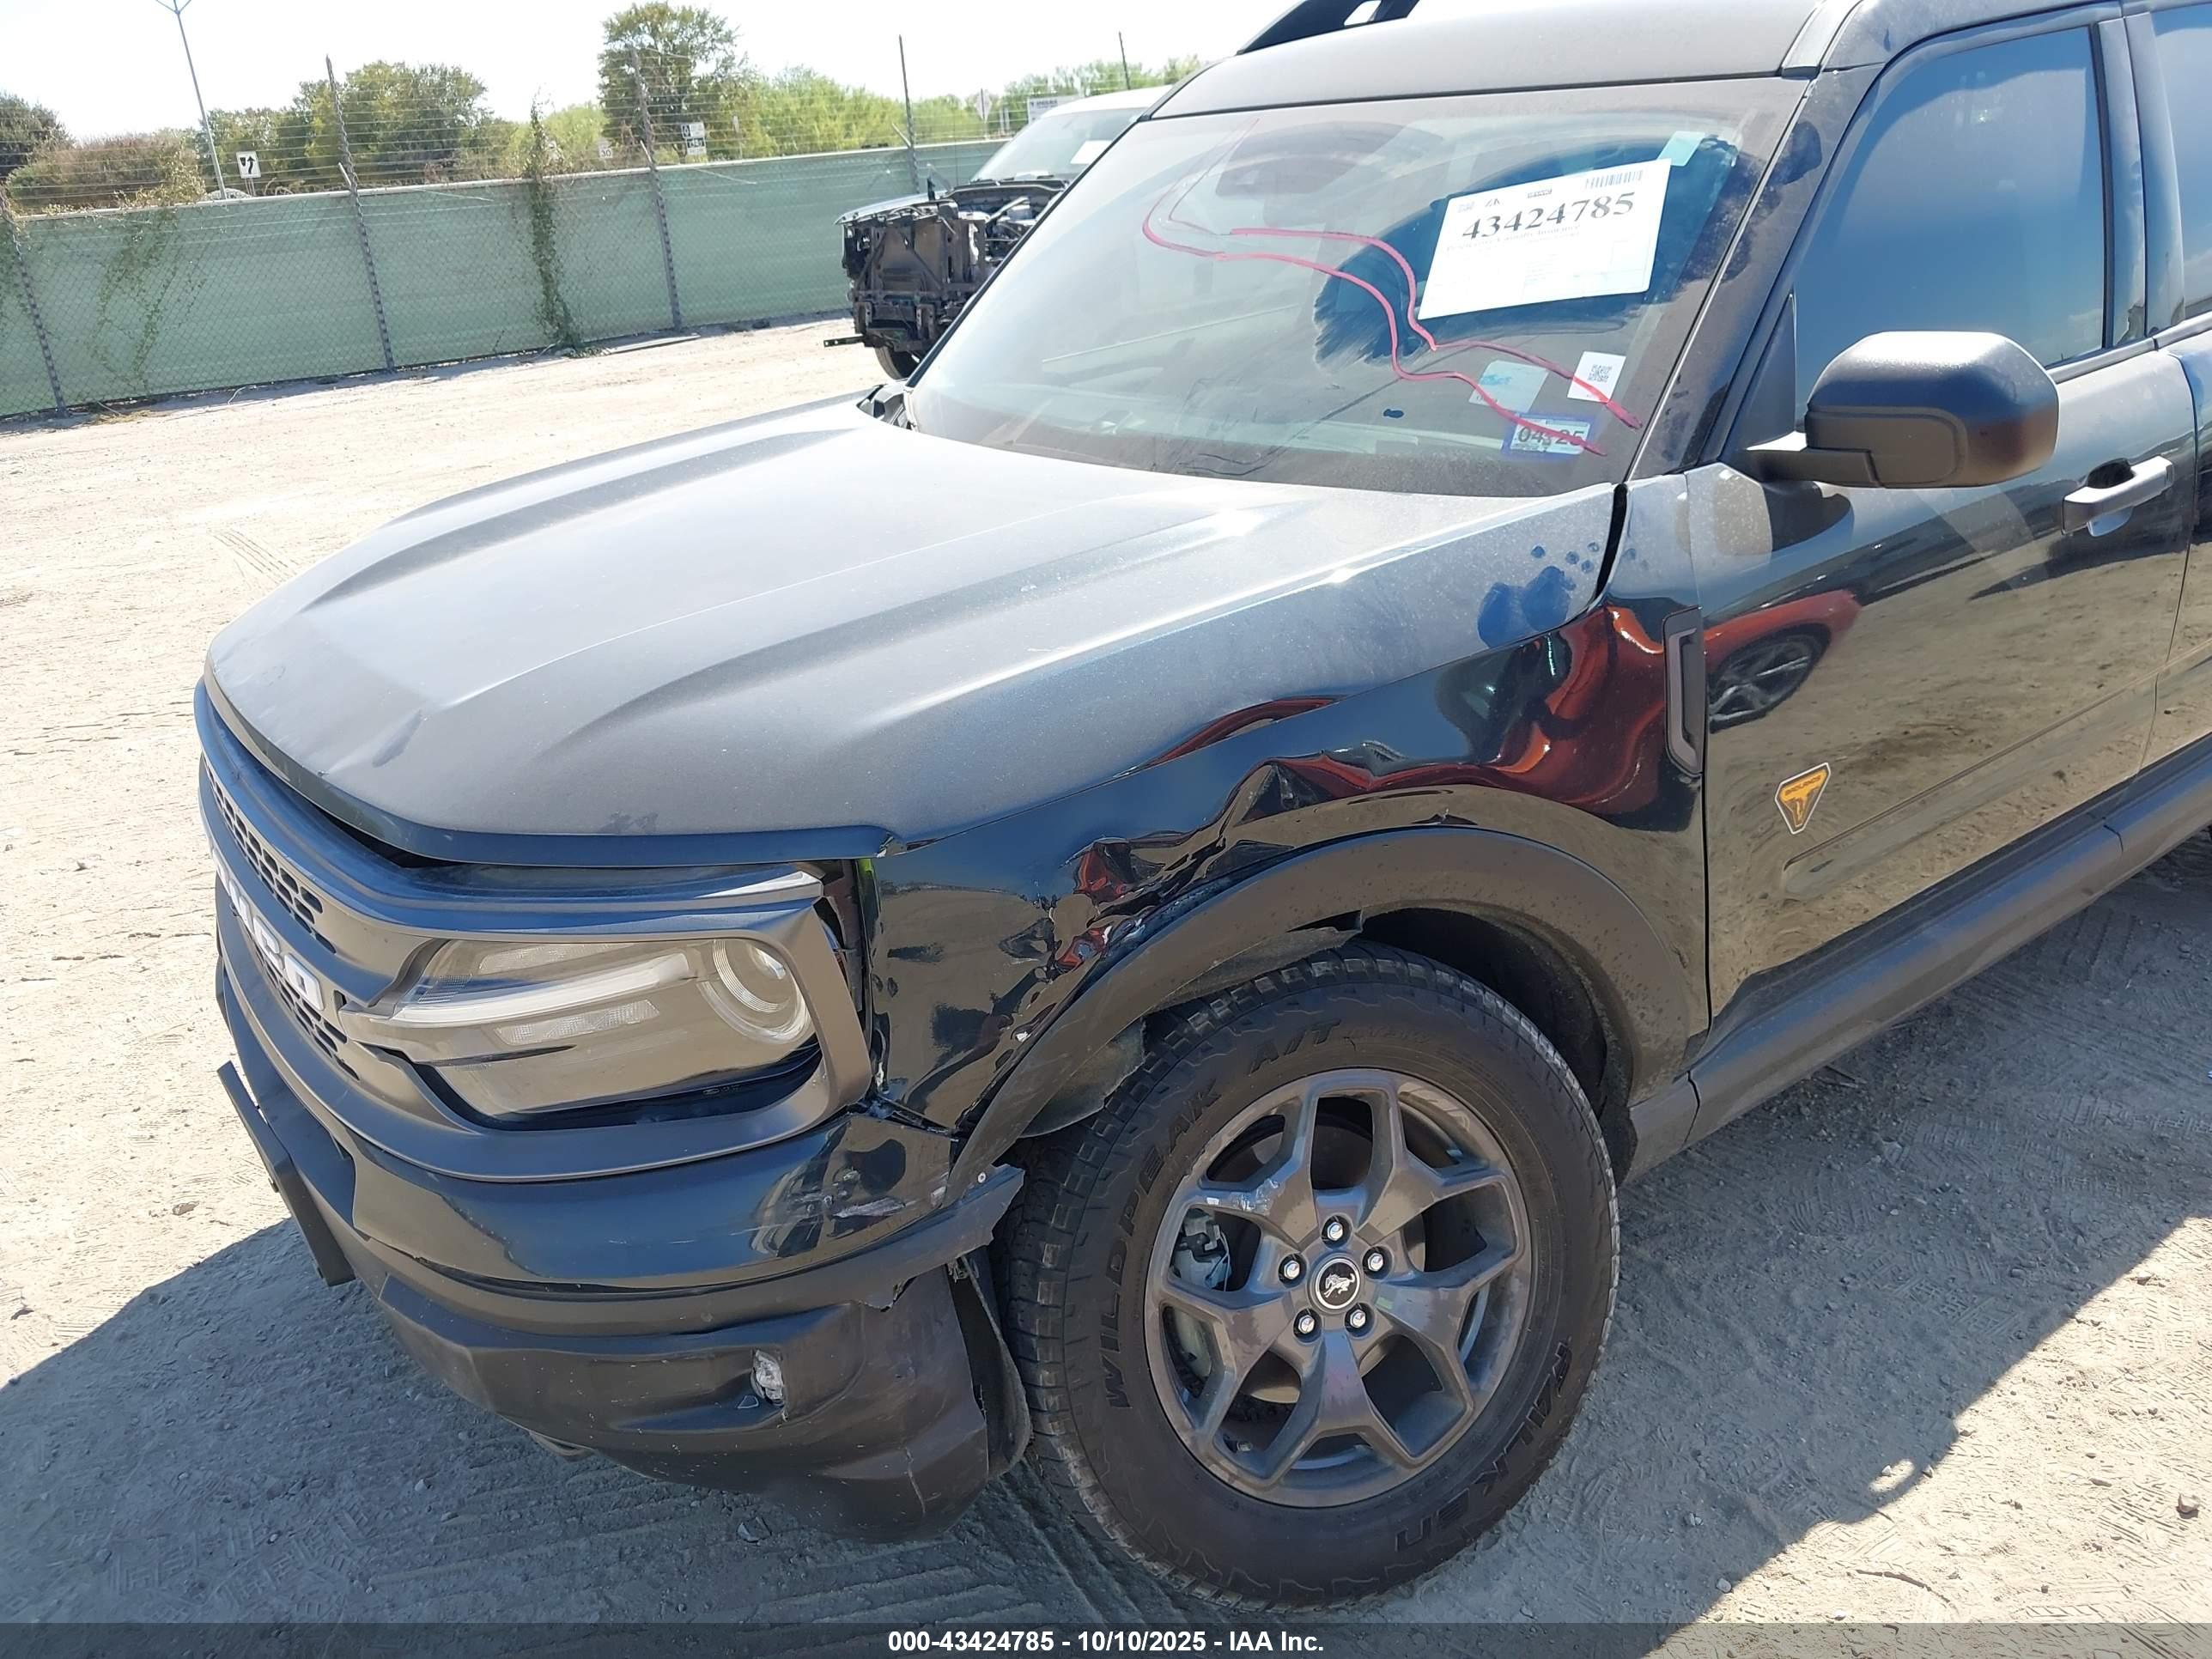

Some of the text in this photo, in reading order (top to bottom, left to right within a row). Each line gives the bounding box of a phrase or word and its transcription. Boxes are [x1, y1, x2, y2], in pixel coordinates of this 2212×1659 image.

[1462, 191, 1636, 240] 43424785
[1099, 1019, 1341, 1410] WILDPEAK A/T
[1395, 1335, 1572, 1553] FALKEN
